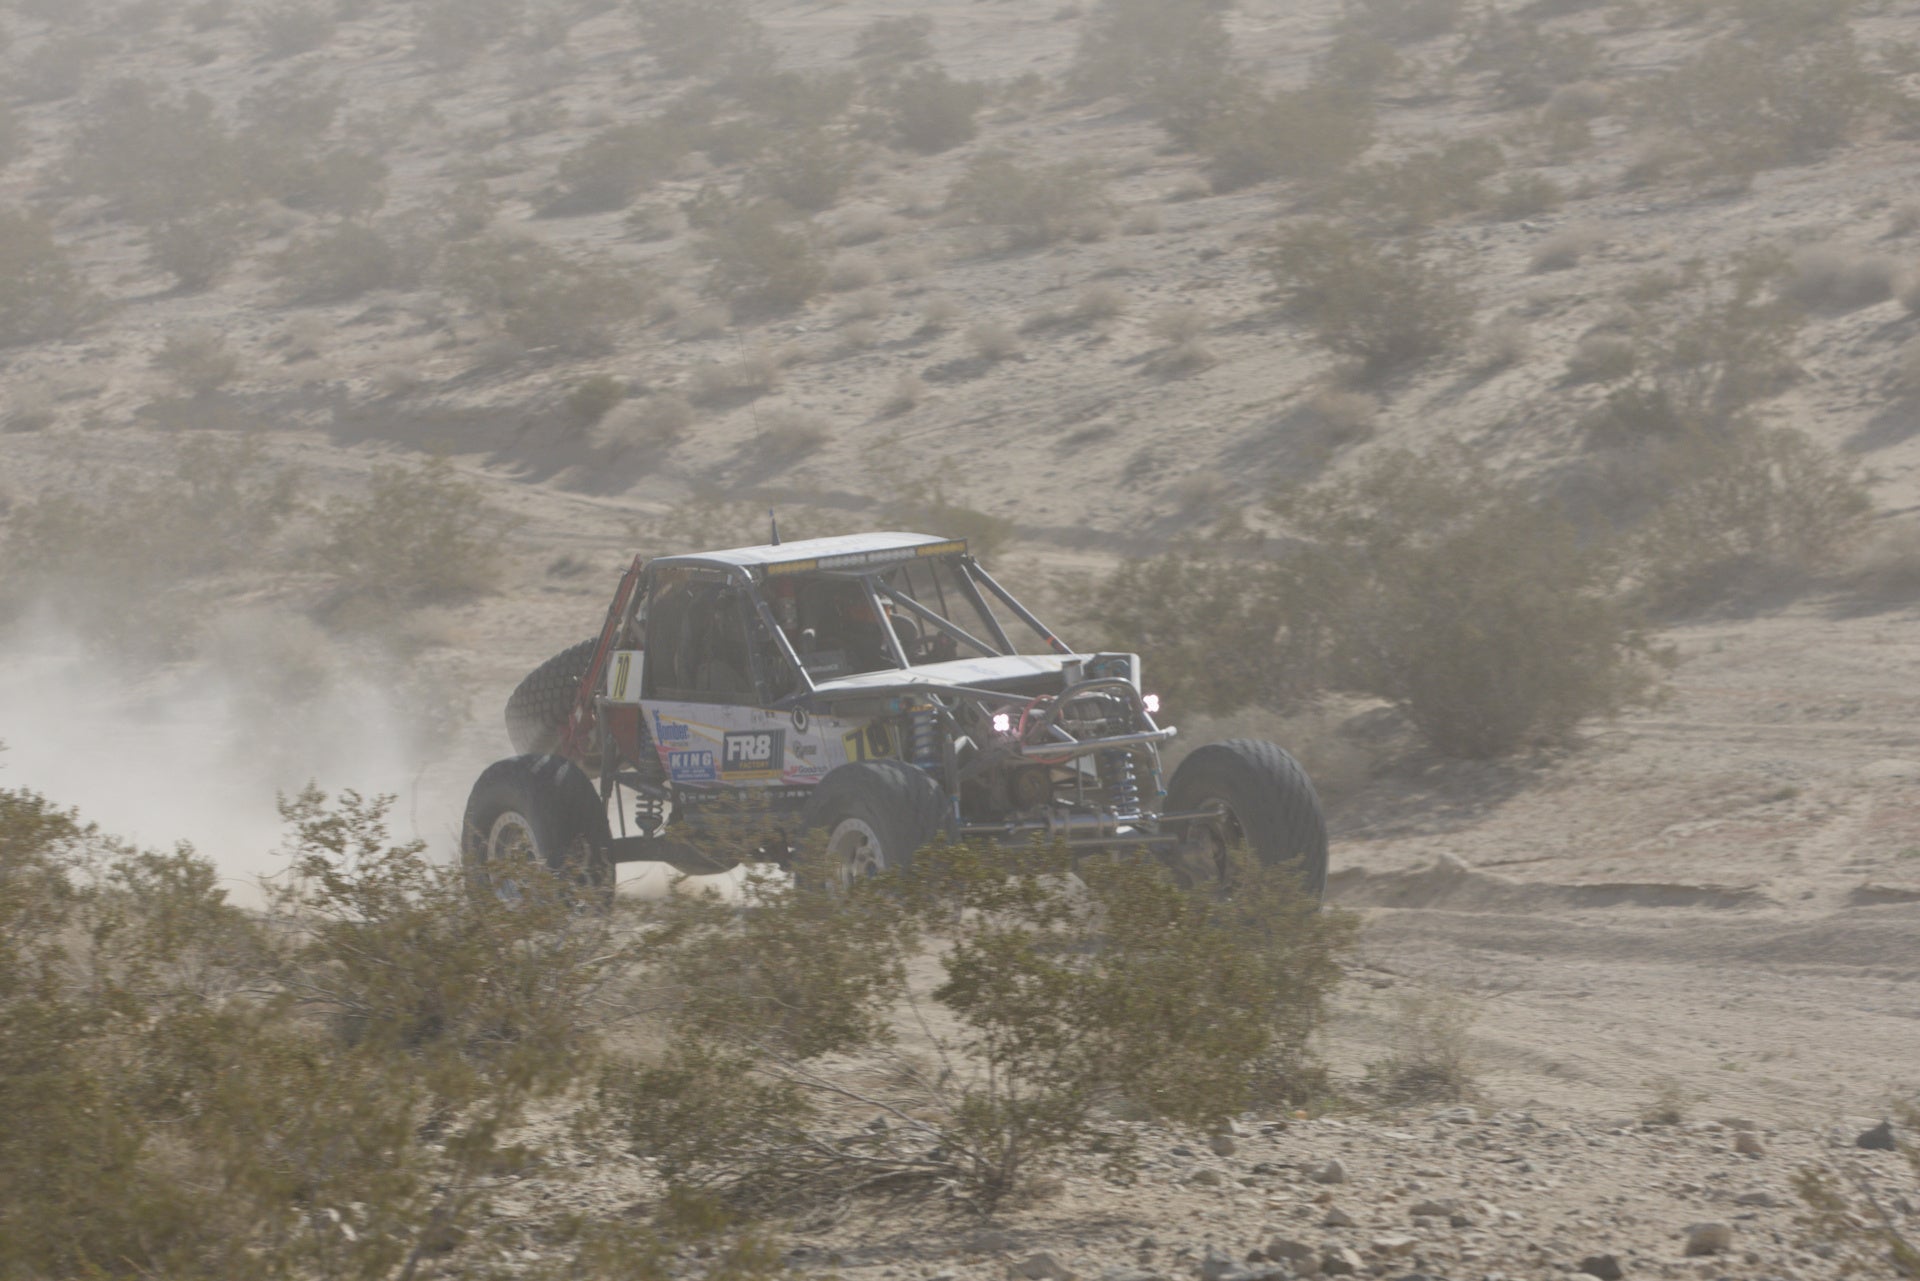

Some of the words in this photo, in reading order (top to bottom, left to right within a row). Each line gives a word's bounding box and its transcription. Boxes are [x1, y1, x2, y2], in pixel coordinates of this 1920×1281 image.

[726, 734, 771, 761] FR8
[845, 721, 891, 763] 70
[671, 752, 712, 768] KING
